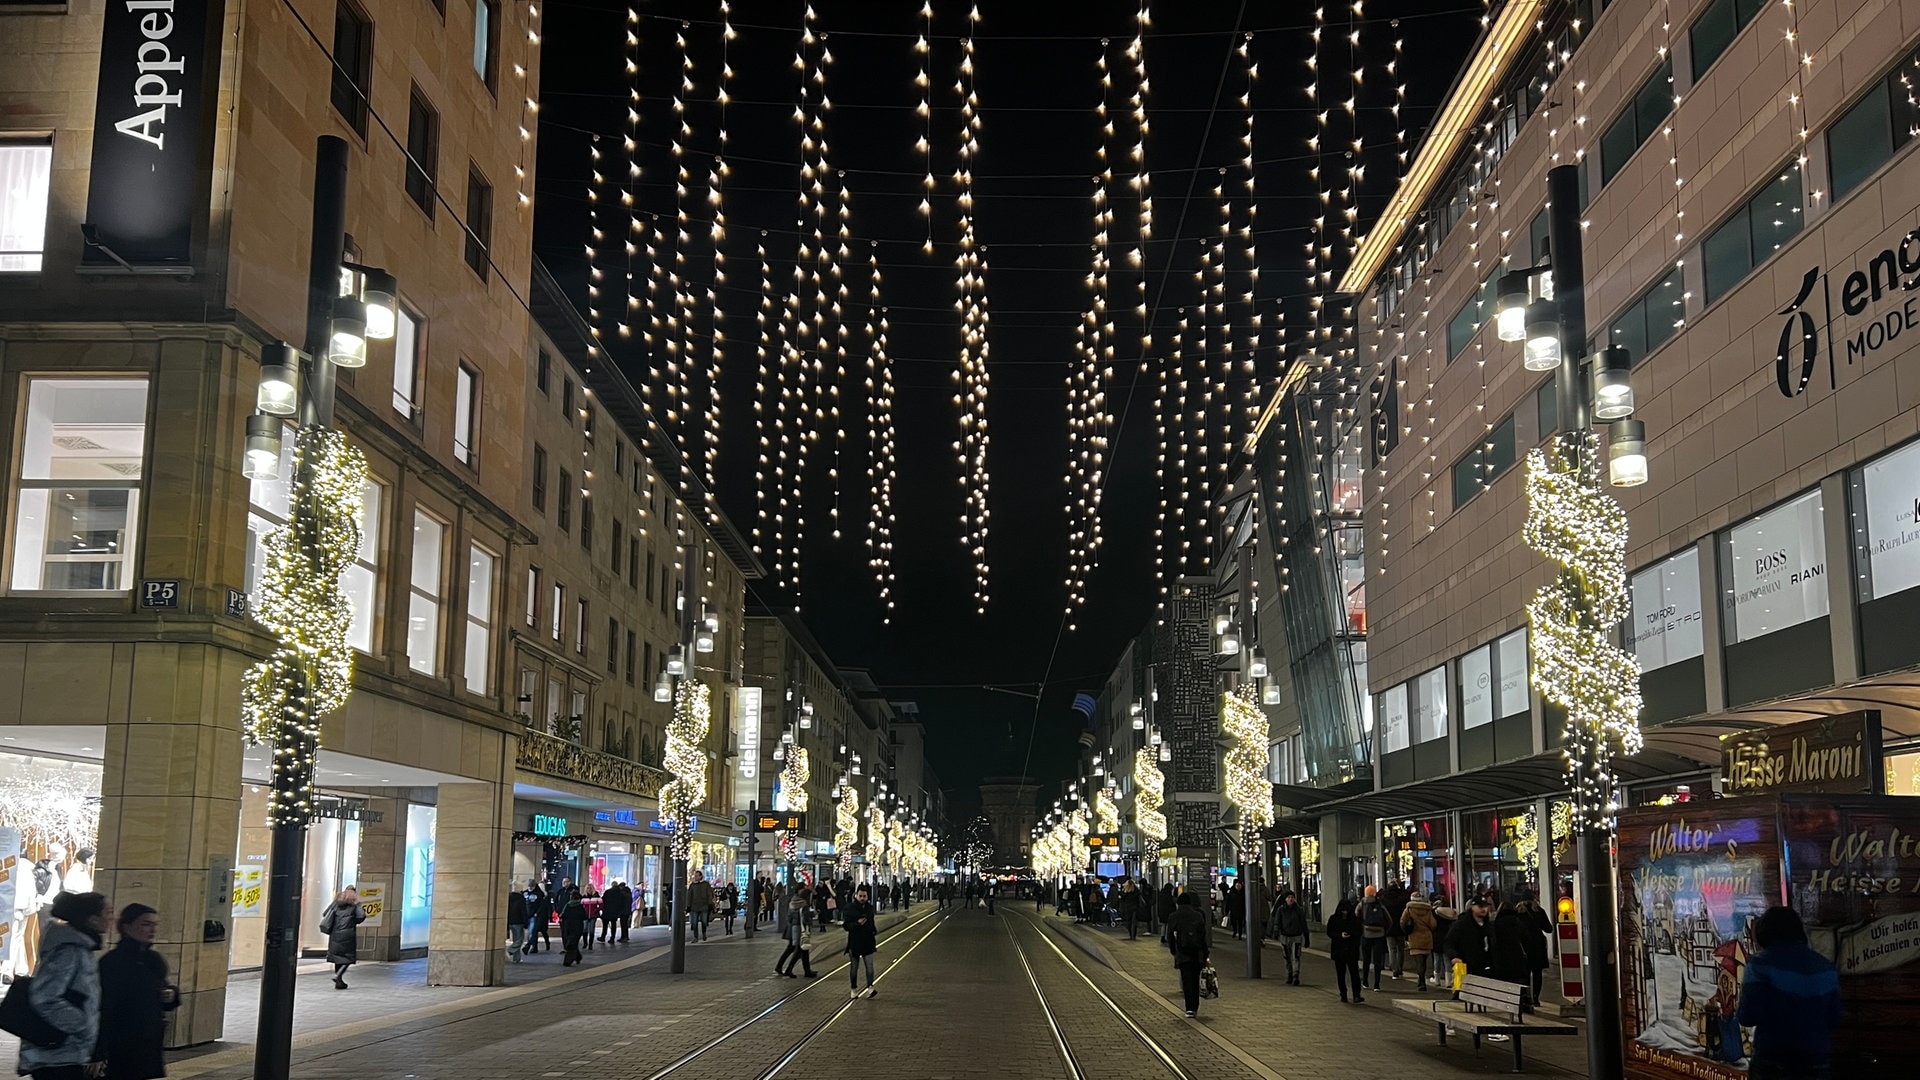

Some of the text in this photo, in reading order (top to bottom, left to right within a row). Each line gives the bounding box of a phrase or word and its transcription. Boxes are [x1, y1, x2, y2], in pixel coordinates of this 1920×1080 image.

[1847, 297, 1919, 365] MODE
[1755, 548, 1787, 575] BOSS
[1790, 563, 1825, 585] RIANI
[1646, 606, 1676, 624] TOM FORD
[739, 692, 759, 778] dielmann
[1728, 732, 1862, 791] Heisse Maroni
[534, 814, 567, 837] DOUGLAS
[1639, 867, 1752, 895] Heisse Maroni
[1808, 869, 1902, 894] Heisse
[1871, 919, 1919, 940] Wir holen
[1863, 938, 1910, 961] Kastanien
[1634, 1044, 1648, 1059] Seit
[1649, 1048, 1690, 1073] Jahrzehnten
